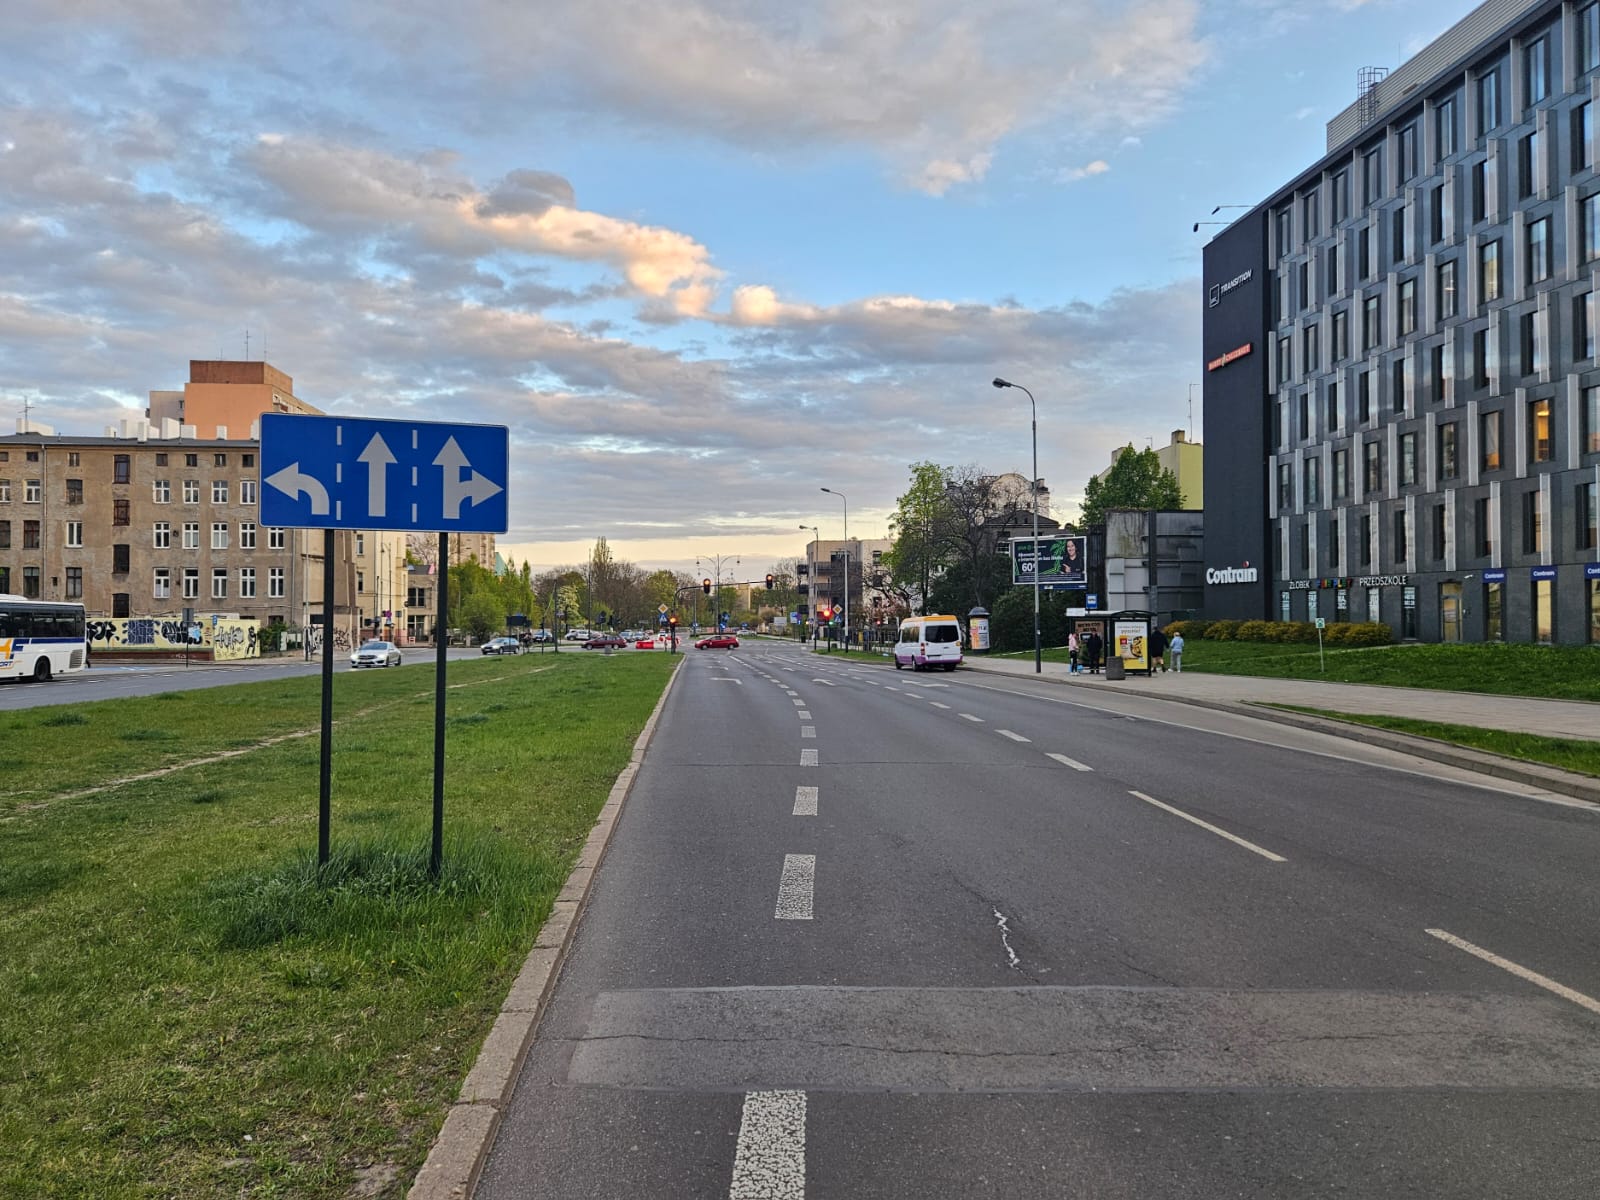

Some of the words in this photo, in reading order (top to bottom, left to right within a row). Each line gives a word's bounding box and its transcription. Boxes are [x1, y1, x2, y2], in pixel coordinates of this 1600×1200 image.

[1221, 269, 1252, 294] TRANSITION
[1206, 561, 1258, 584] Contrain
[1359, 576, 1407, 586] PRZEDSZKOLE
